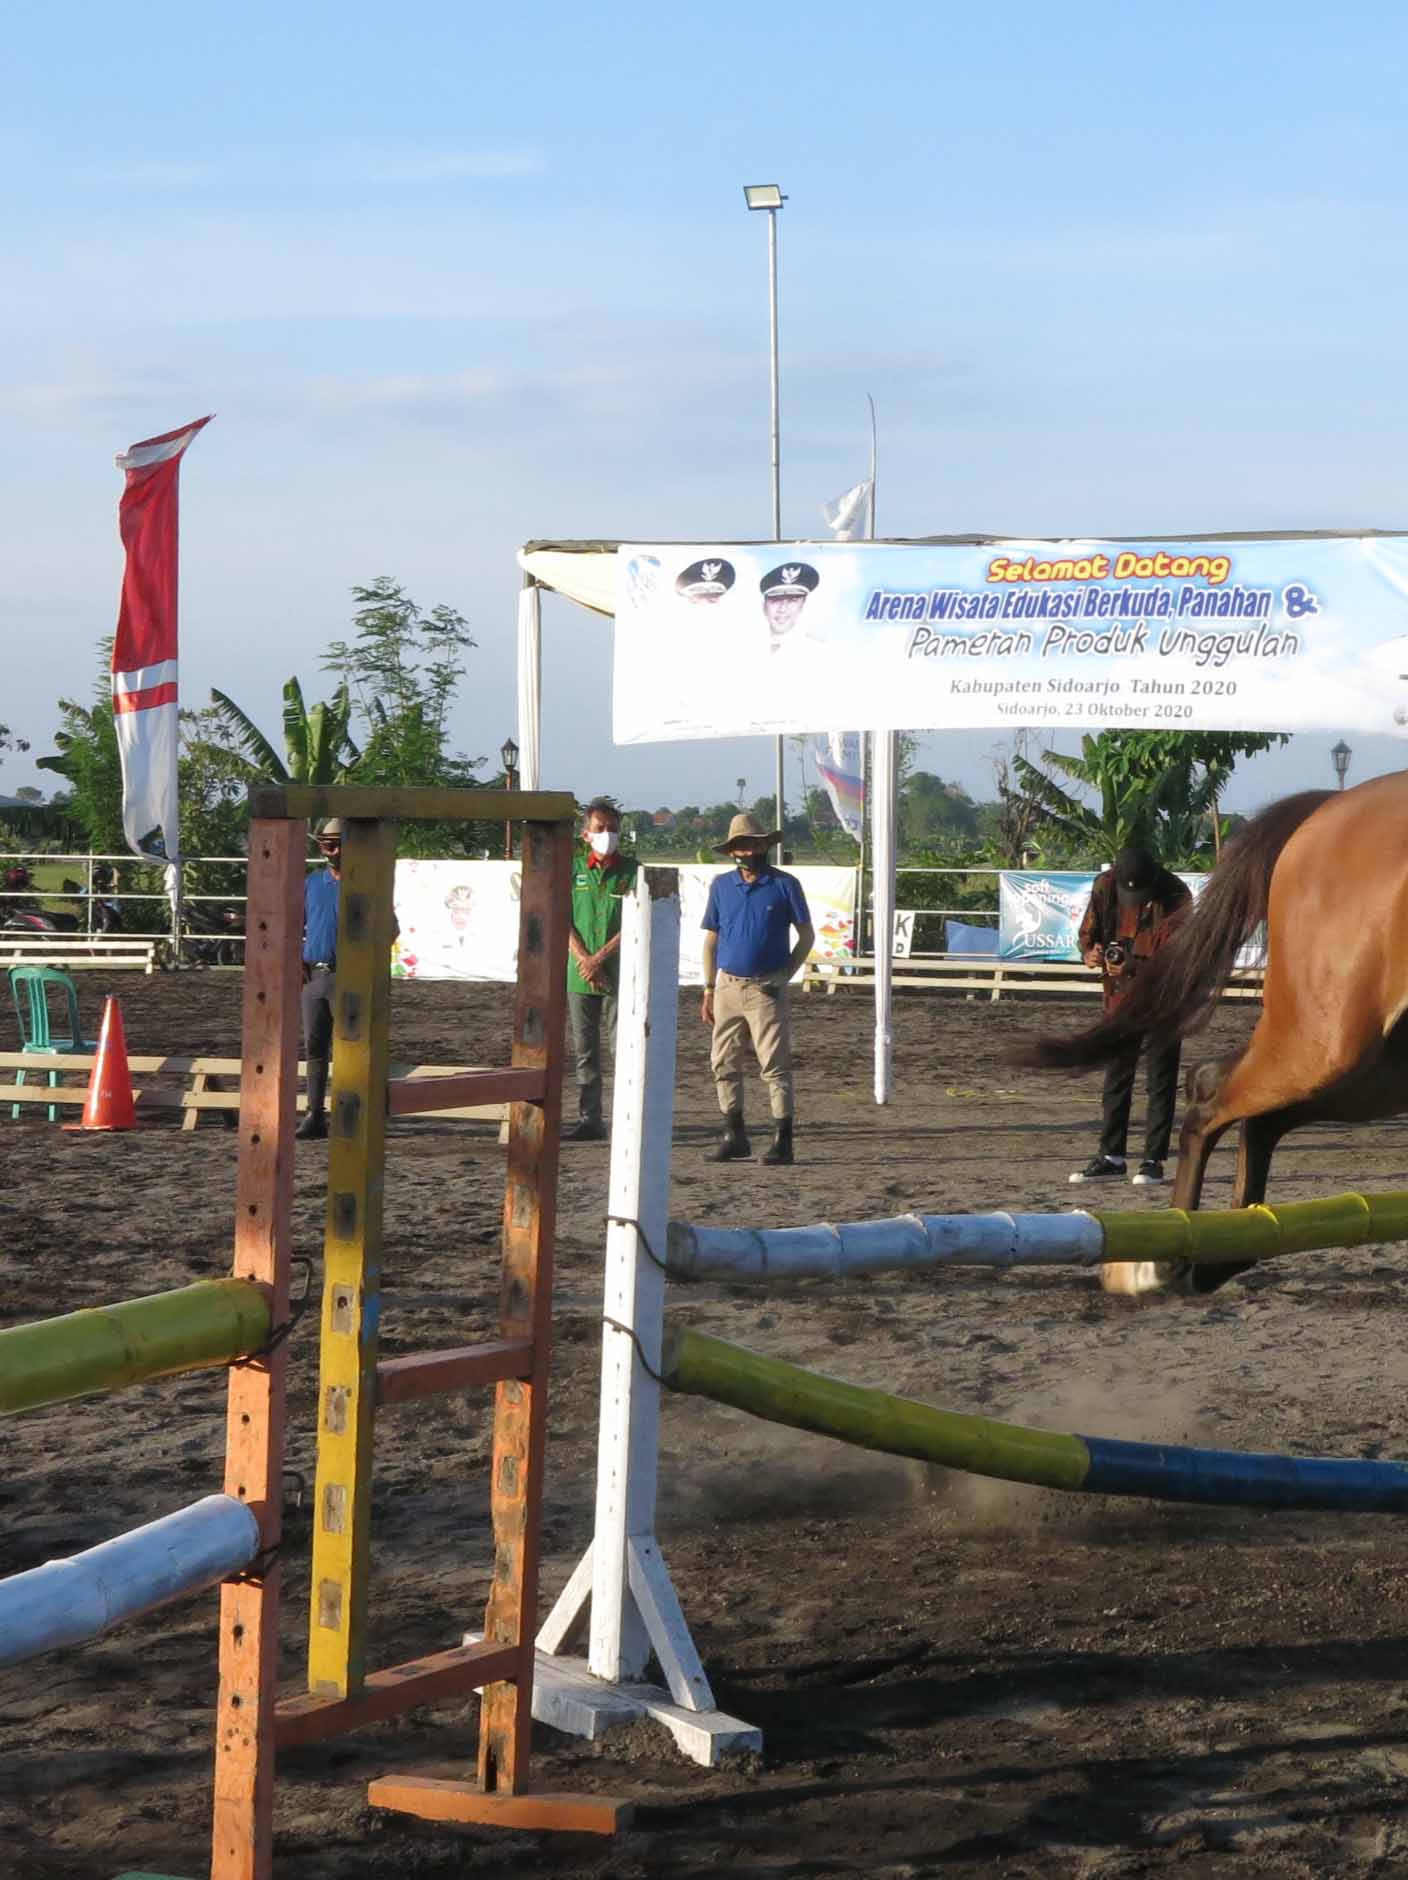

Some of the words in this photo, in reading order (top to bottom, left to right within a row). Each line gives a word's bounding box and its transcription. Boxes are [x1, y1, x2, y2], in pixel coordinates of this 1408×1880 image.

[986, 554, 1110, 583] Selamat
[1113, 552, 1231, 585] Datang
[866, 591, 926, 620] Arena
[929, 591, 1000, 620] Wisata
[1002, 589, 1082, 619] Edukasi
[1083, 587, 1173, 619] Berkuda,
[1178, 587, 1271, 617] Panahan
[1285, 587, 1318, 617] &
[908, 627, 1031, 658] Pameran
[1042, 623, 1148, 656] Produk
[1160, 623, 1298, 667] Unggulan
[950, 679, 1041, 696] Kabupaten
[1047, 679, 1120, 696] Sidoarjo
[1131, 679, 1185, 694] Tahun
[1190, 680, 1237, 695] 2020
[1065, 703, 1082, 716] 23
[1088, 703, 1149, 716] Oktober
[1154, 705, 1193, 718] 2020
[896, 914, 911, 937] K
